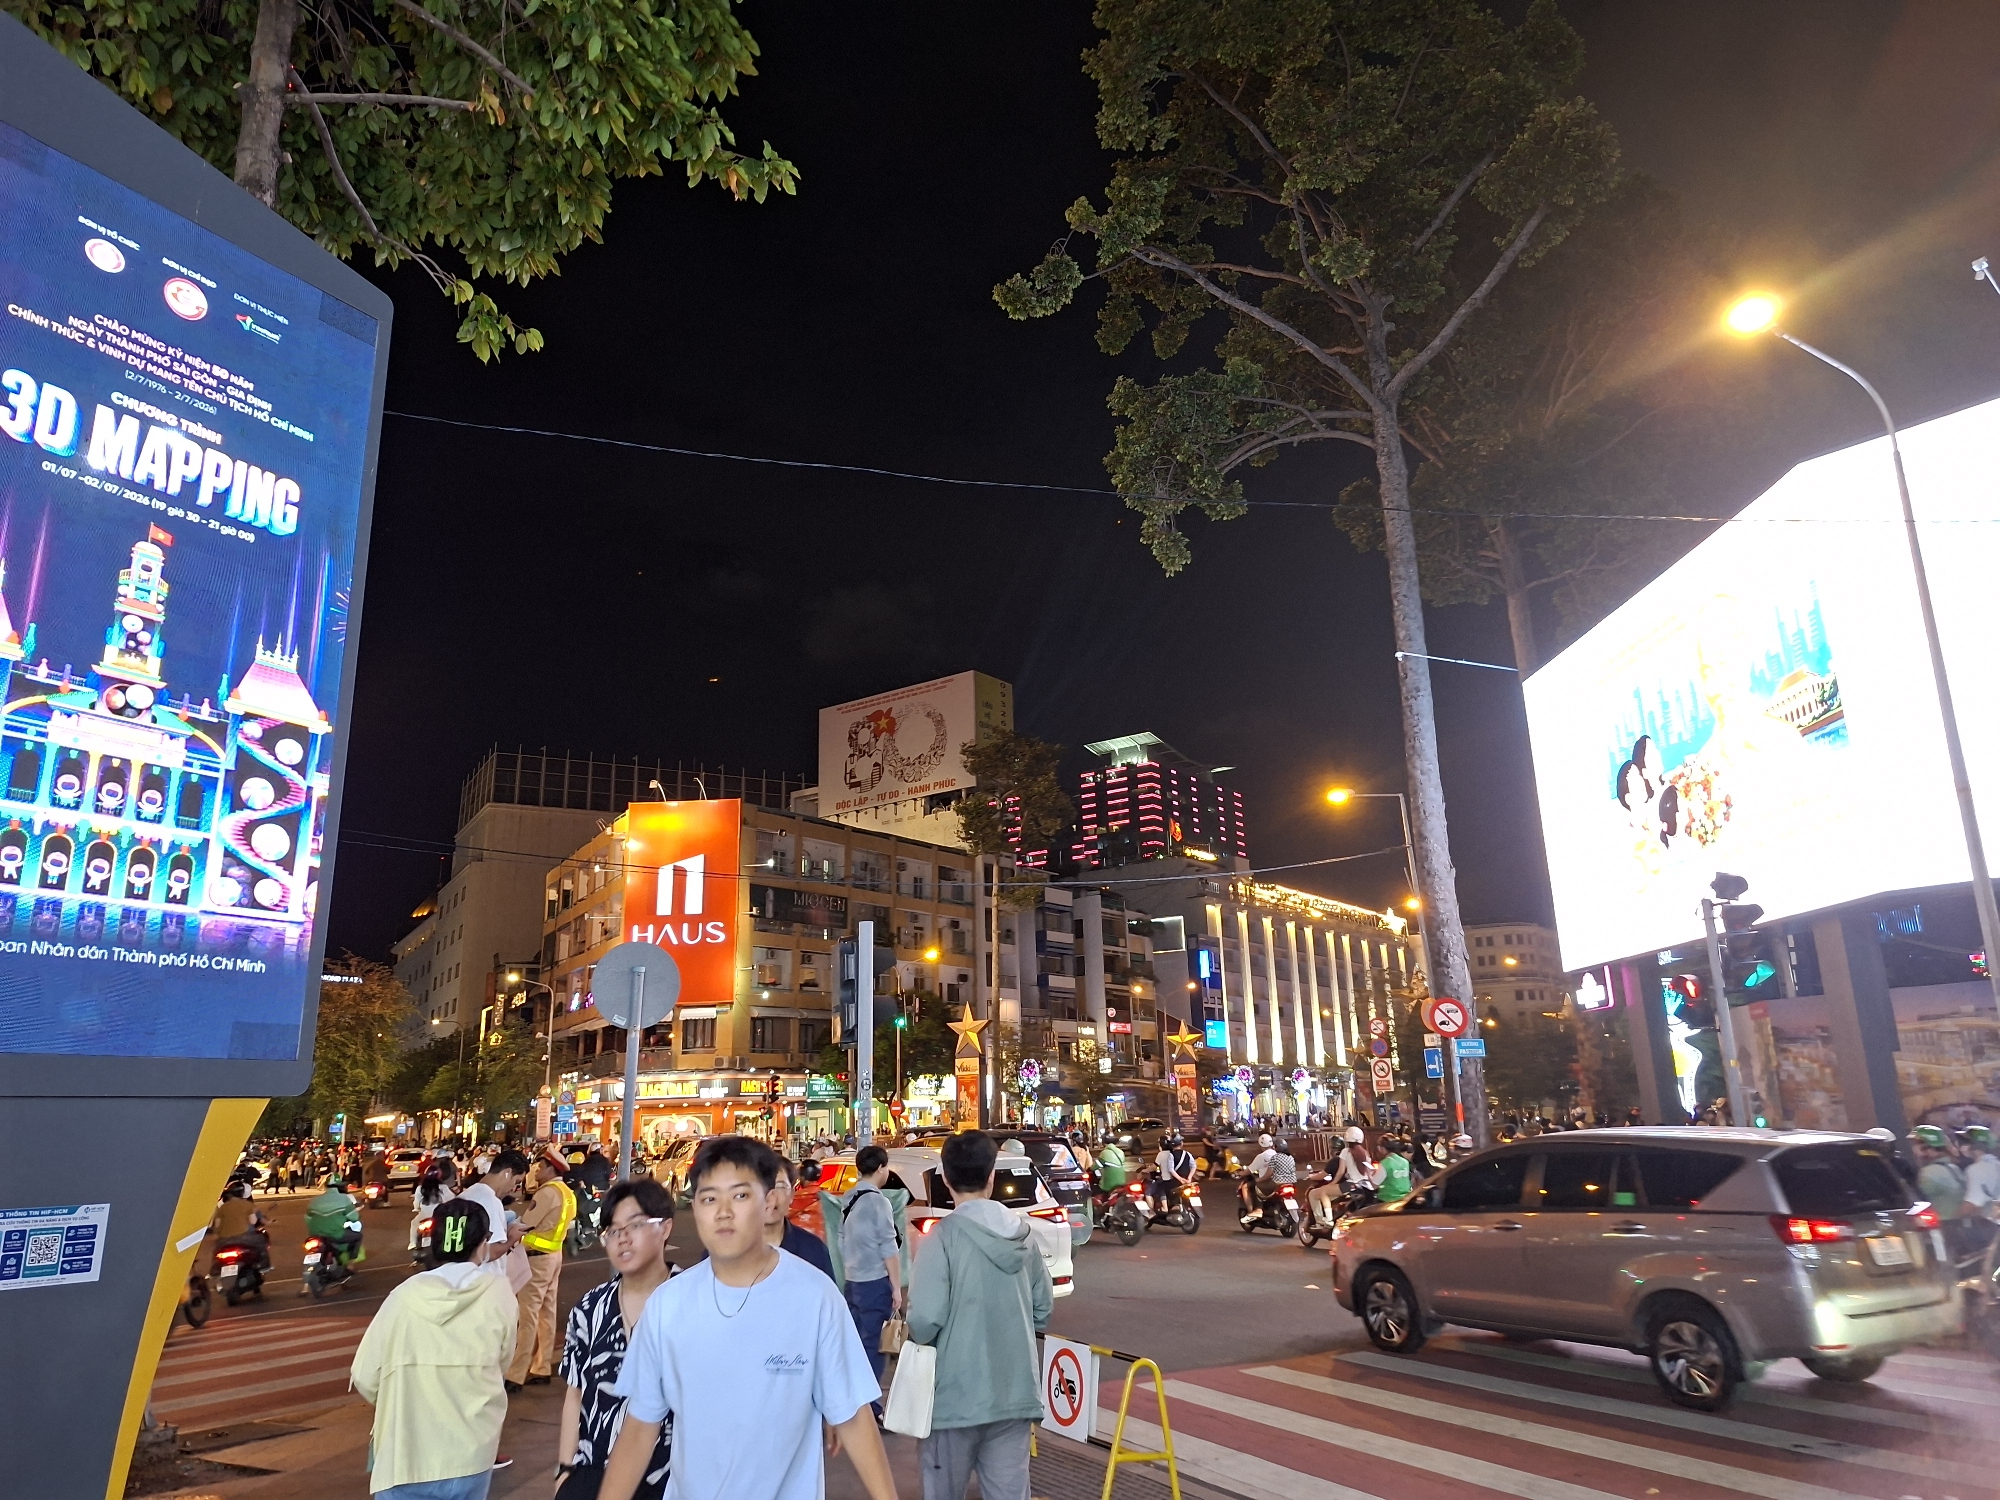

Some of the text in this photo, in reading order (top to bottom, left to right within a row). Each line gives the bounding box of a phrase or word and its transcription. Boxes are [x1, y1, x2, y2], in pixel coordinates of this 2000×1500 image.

[7, 303, 314, 442] CHÍNH THỨC & VINH DỰ MANG TÊN CHỦ TỊCH HỒ CHÍ MINH
[67, 315, 106, 338] NGÀY
[105, 331, 145, 356] THÀNH
[145, 350, 171, 368] PHỐ
[172, 360, 191, 376] SÀI
[191, 370, 218, 388] GÒN
[226, 385, 246, 401] GIA
[246, 394, 273, 413] ĐỊNH
[93, 314, 130, 335] CHÀO
[130, 331, 167, 352] MỪNG
[184, 353, 211, 373] NIỆM
[211, 364, 230, 380] 50
[229, 373, 255, 391] NĂM
[110, 391, 223, 445] CHƯƠNG TRÌNH
[124, 369, 168, 395] (2/7/1976
[174, 390, 218, 416] 2/7/2026)
[0, 368, 302, 537] 3D MAPPING
[41, 459, 78, 480] 01/07
[150, 499, 168, 516] (19
[166, 503, 186, 520] giờ
[185, 510, 201, 524] 30
[207, 518, 221, 531] 21
[220, 522, 238, 538] giờ
[237, 529, 256, 544] 00)
[835, 799, 852, 811] ĐỘC
[853, 795, 869, 808] LẬP
[876, 791, 888, 804] TỰ
[888, 789, 900, 800] DO
[907, 783, 931, 796] HẠNH
[933, 777, 957, 790] PHÚC
[30, 940, 74, 958] Nhân
[77, 944, 109, 961] dân
[111, 946, 157, 966] Thành
[158, 953, 187, 968] phố
[189, 954, 211, 969] Hồ
[211, 955, 236, 971] Chí
[236, 957, 267, 974] Minh
[632, 921, 726, 945] HAUS
[443, 1215, 468, 1253] H
